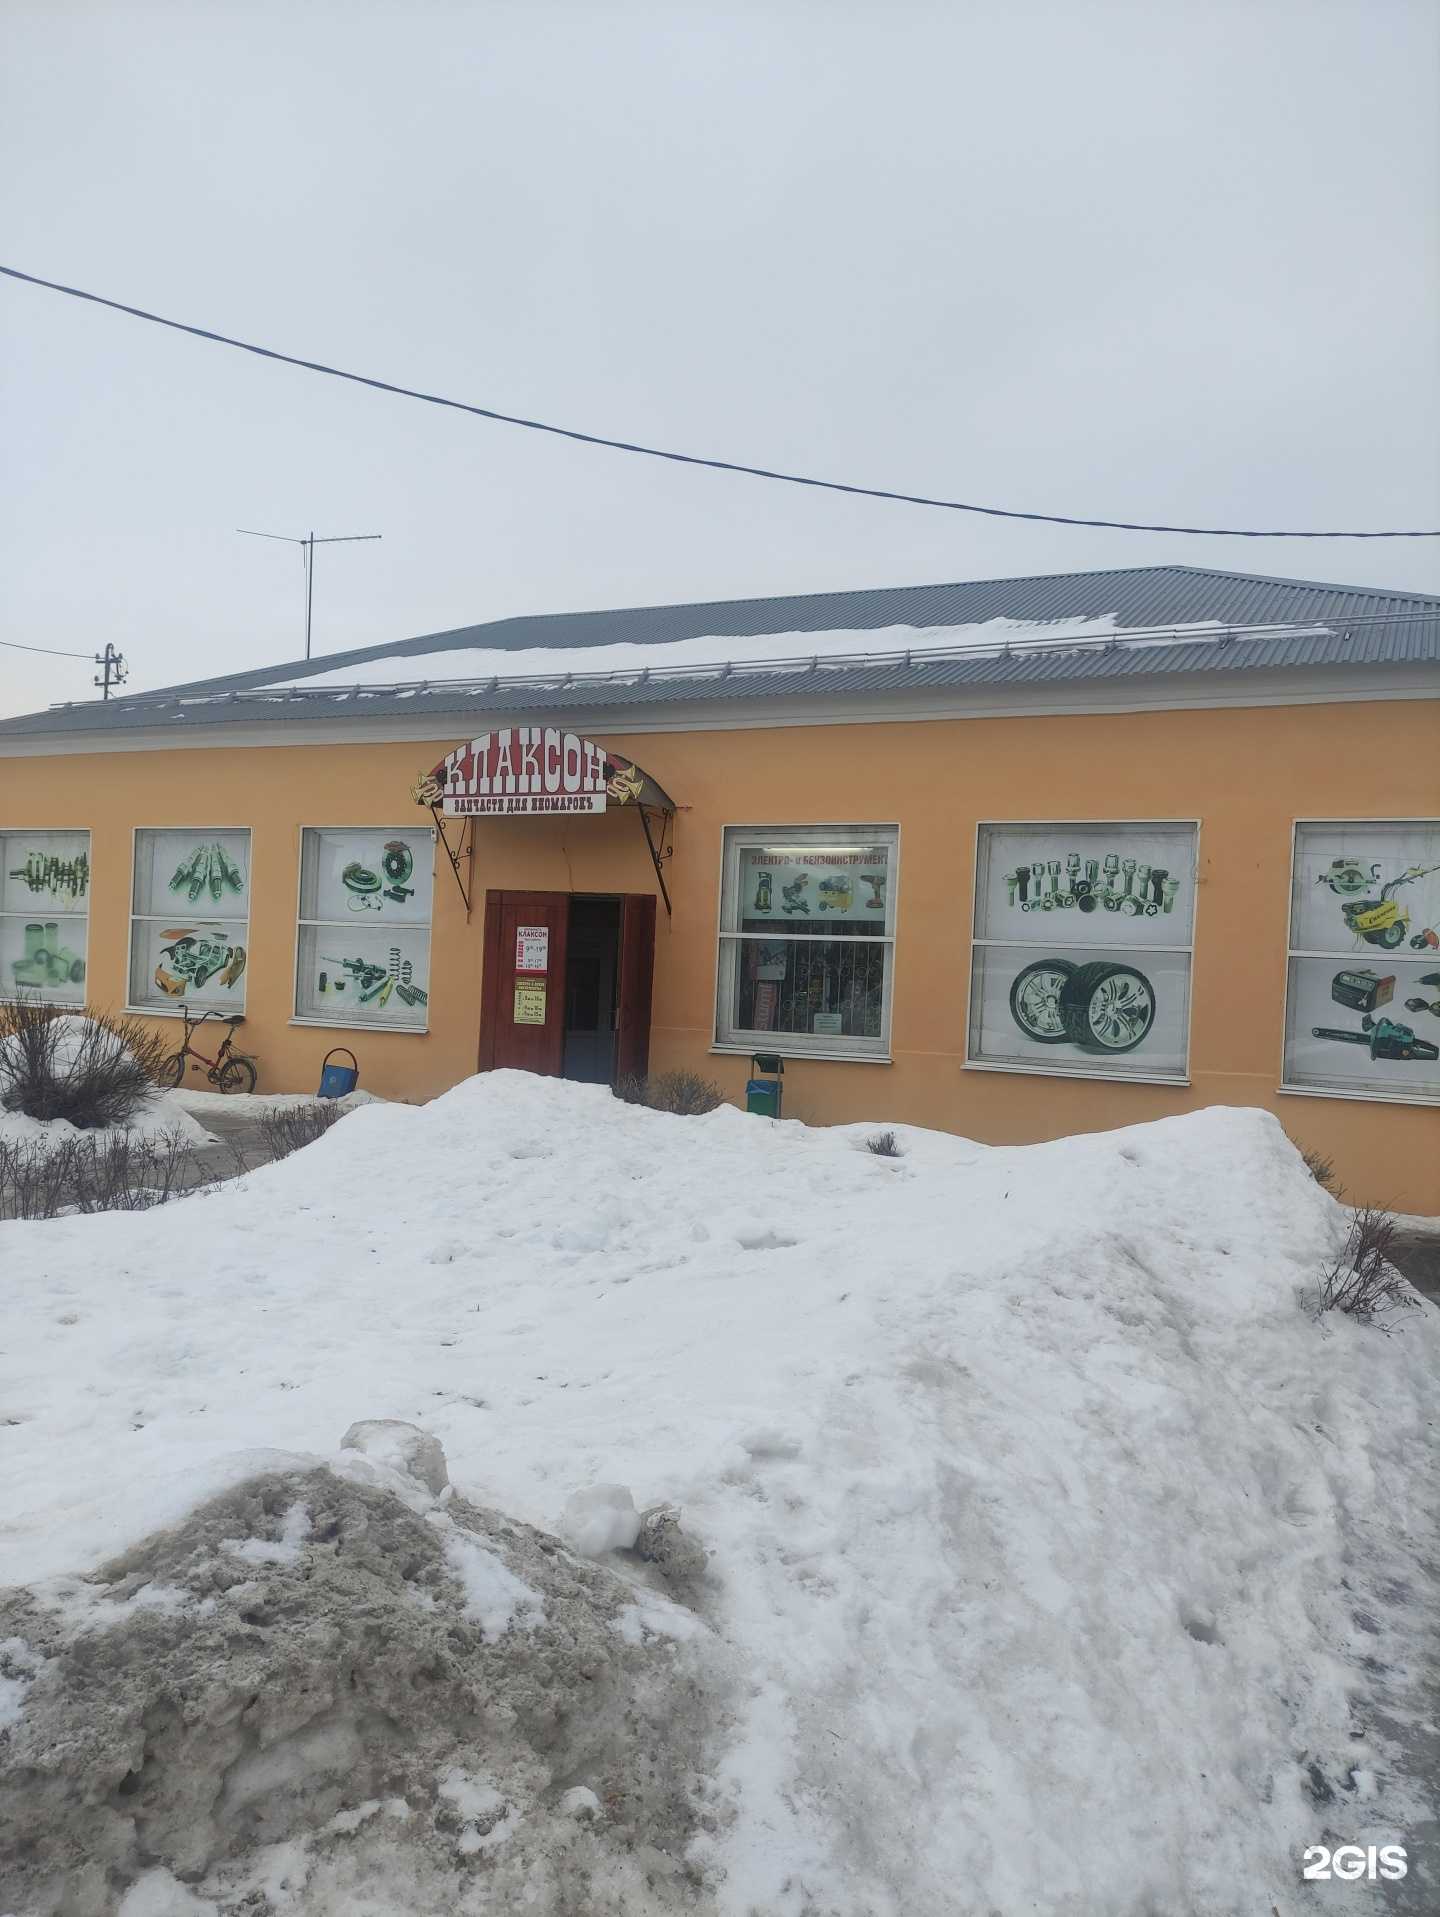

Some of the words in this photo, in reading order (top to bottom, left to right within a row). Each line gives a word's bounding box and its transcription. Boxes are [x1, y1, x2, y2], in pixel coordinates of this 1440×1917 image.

[444, 727, 607, 795] КЛАКСОН
[454, 798, 504, 813] ЗАПЧАСТИ
[506, 798, 528, 813] ДЛЯ
